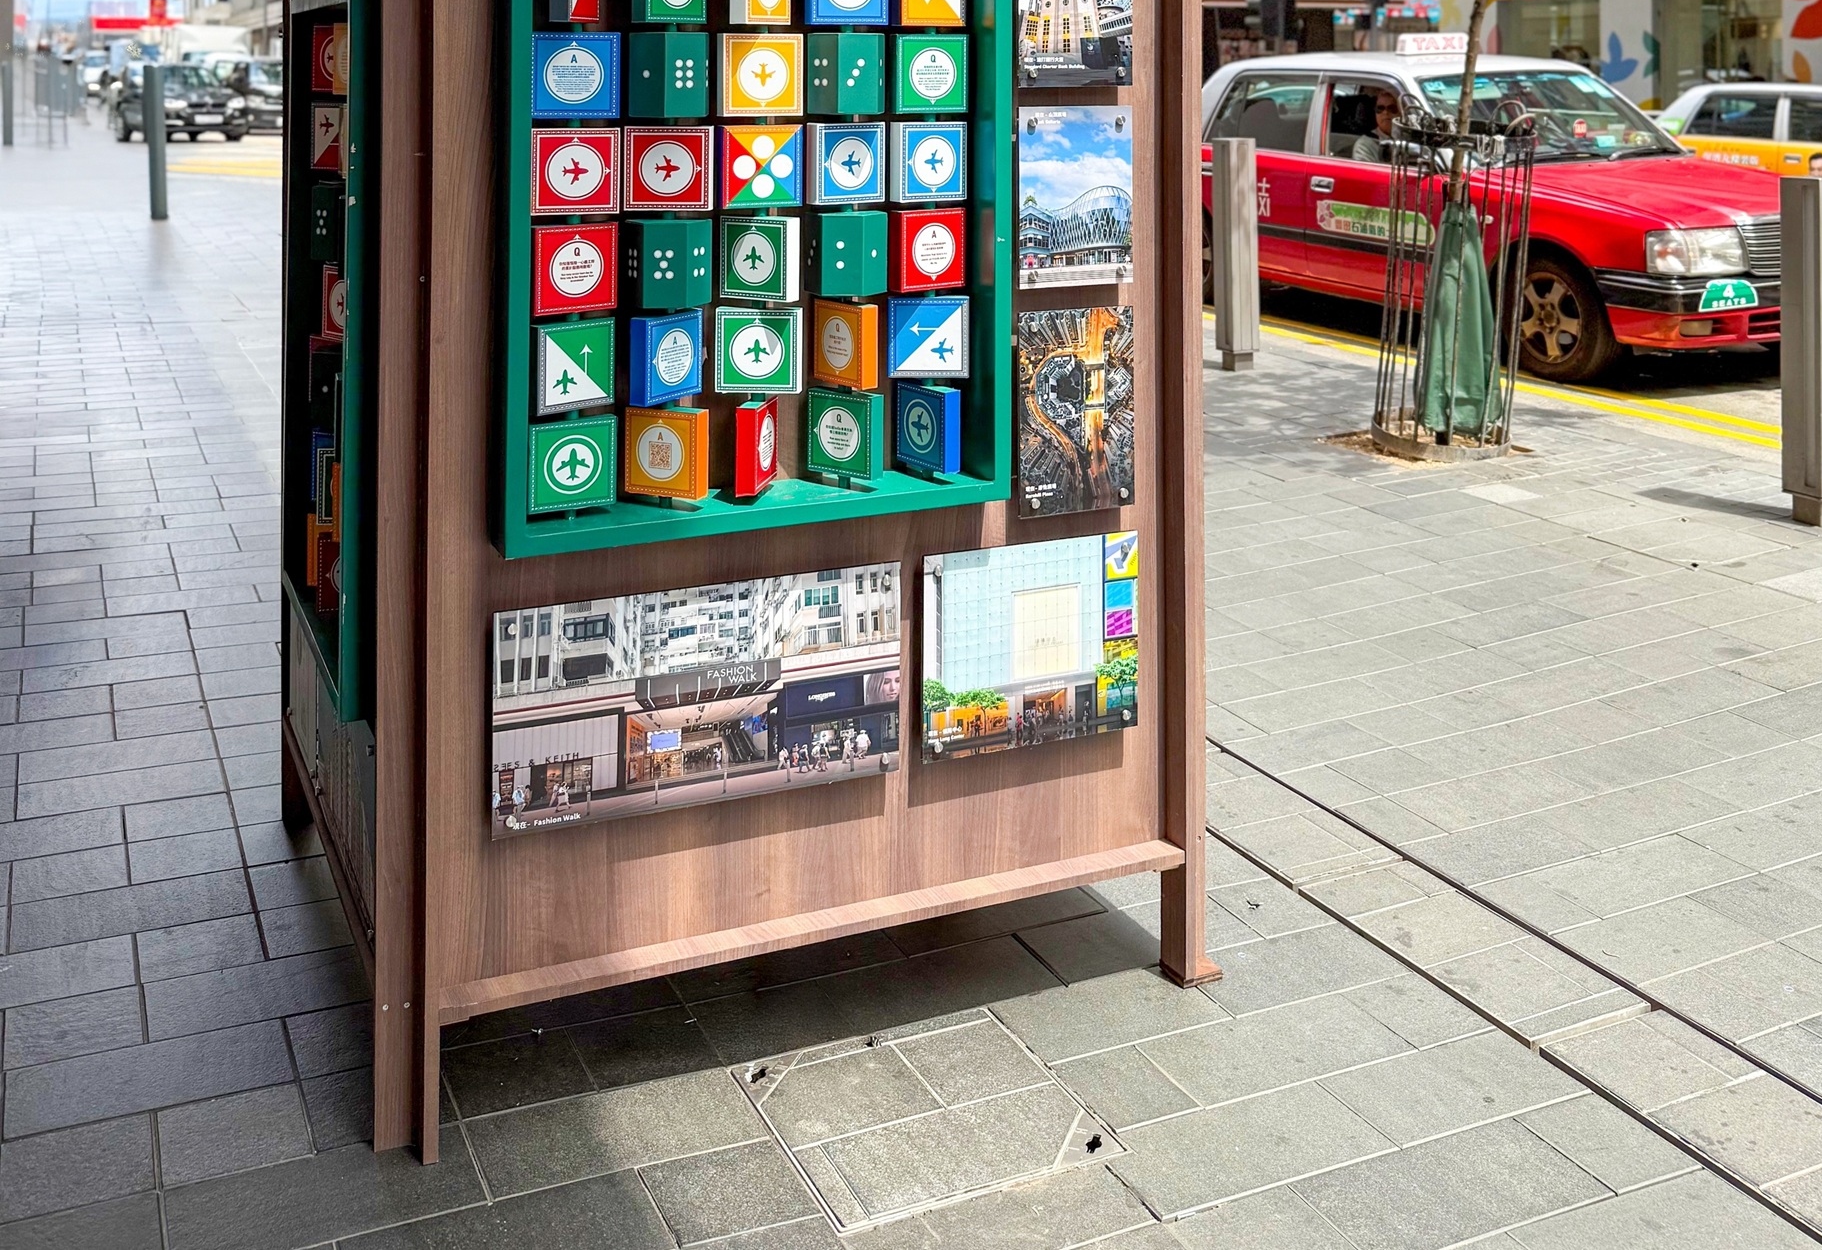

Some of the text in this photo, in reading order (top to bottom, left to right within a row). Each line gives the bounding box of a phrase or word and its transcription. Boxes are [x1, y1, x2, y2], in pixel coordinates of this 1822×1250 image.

[1413, 36, 1464, 50] TAXI
[1723, 284, 1735, 298] 4
[1712, 297, 1746, 308] SEATS
[707, 665, 754, 680] FASHION
[728, 672, 757, 686] WALK
[545, 752, 580, 764] KEITH
[534, 812, 581, 827] Fashion Walk
